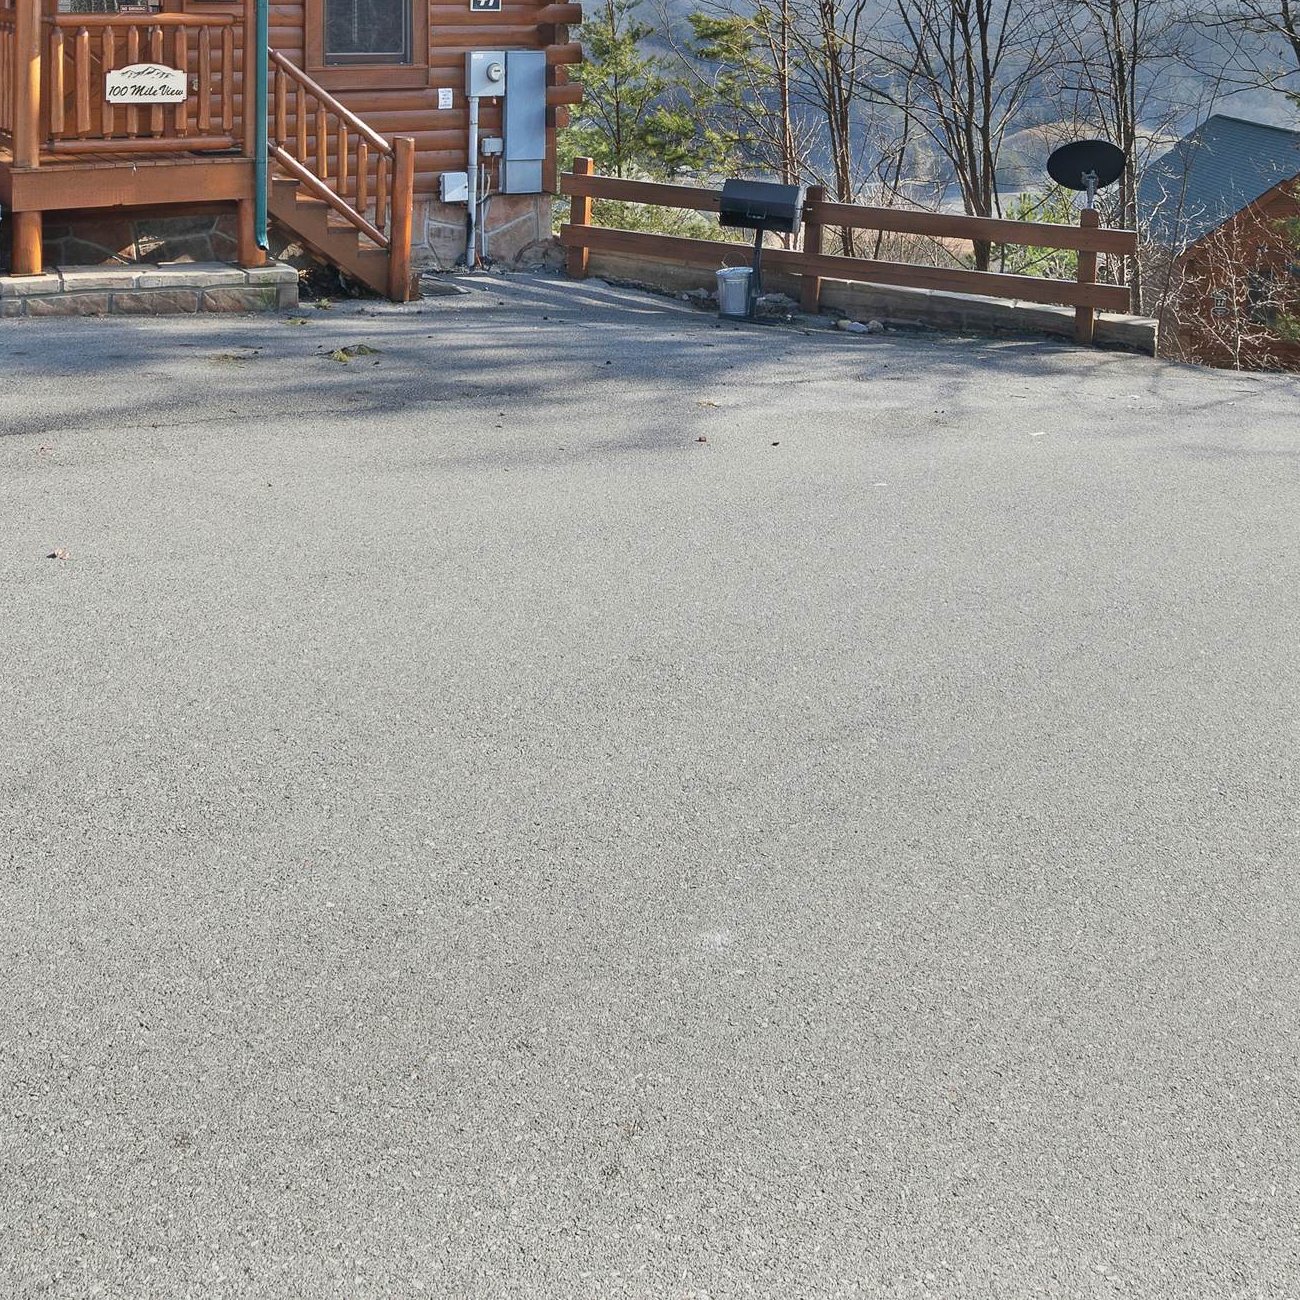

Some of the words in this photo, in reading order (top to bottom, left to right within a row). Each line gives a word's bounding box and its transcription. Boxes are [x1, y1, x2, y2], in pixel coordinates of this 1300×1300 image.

[108, 85, 128, 96] 100
[130, 85, 158, 96] Mile
[159, 85, 183, 96] View
